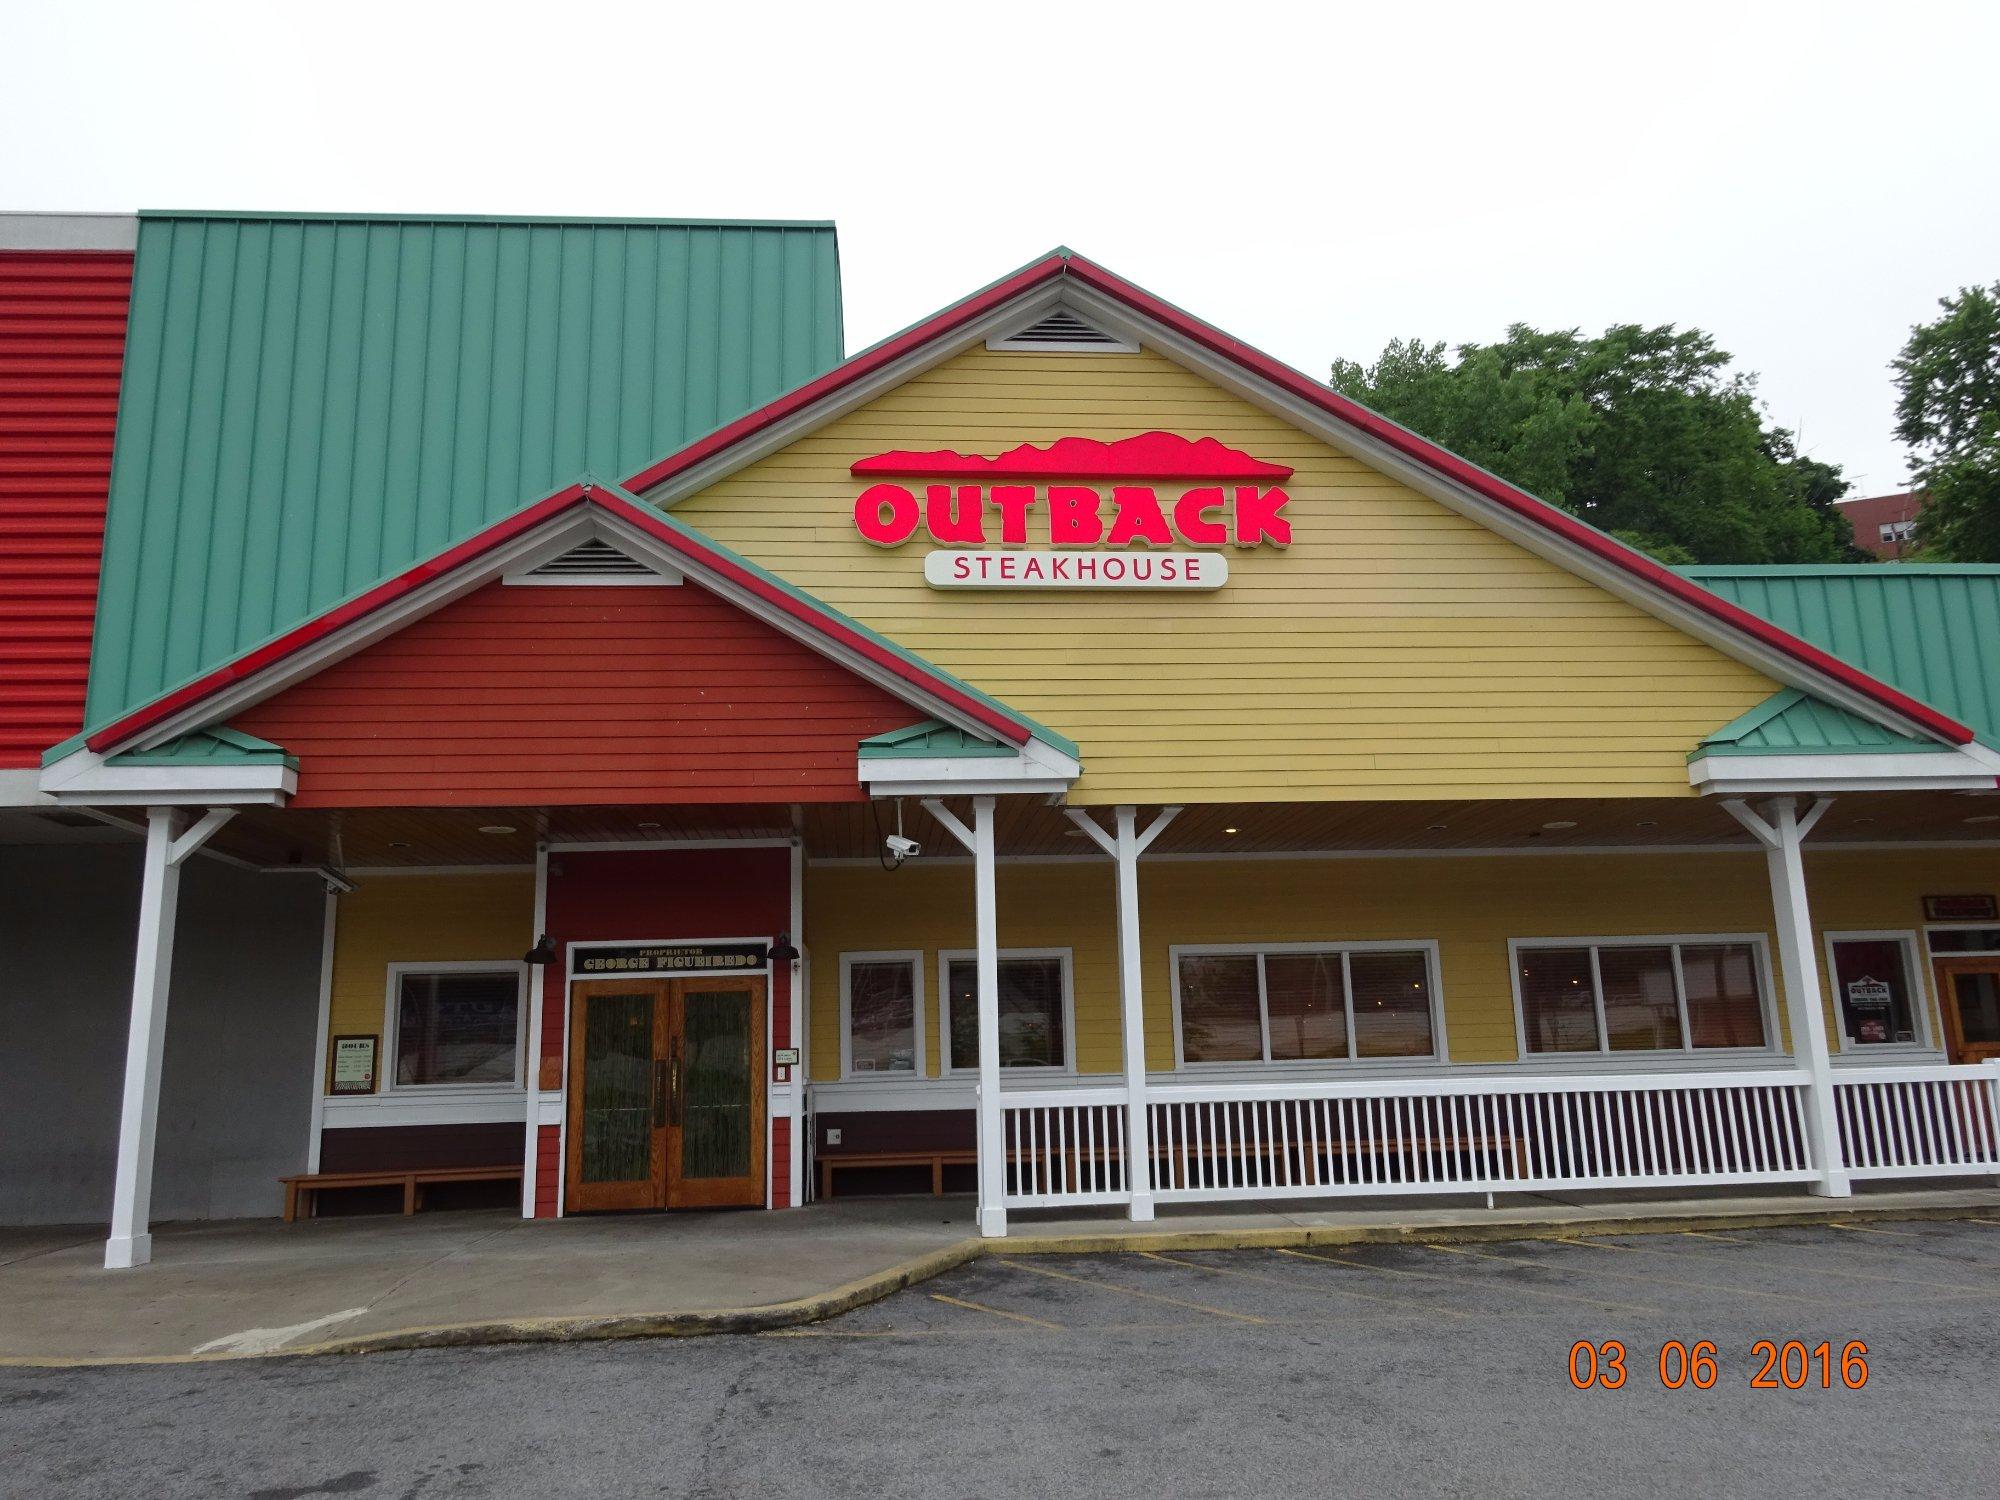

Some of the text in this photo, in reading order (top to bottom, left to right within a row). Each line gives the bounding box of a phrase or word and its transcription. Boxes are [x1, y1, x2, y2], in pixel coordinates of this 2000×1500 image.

[853, 484, 1292, 549] OUTBACK
[953, 557, 1201, 580] STEAKHOUSE
[639, 948, 703, 956] PROPRIETOR
[584, 955, 758, 970] GEORGE FIGUEIREDO
